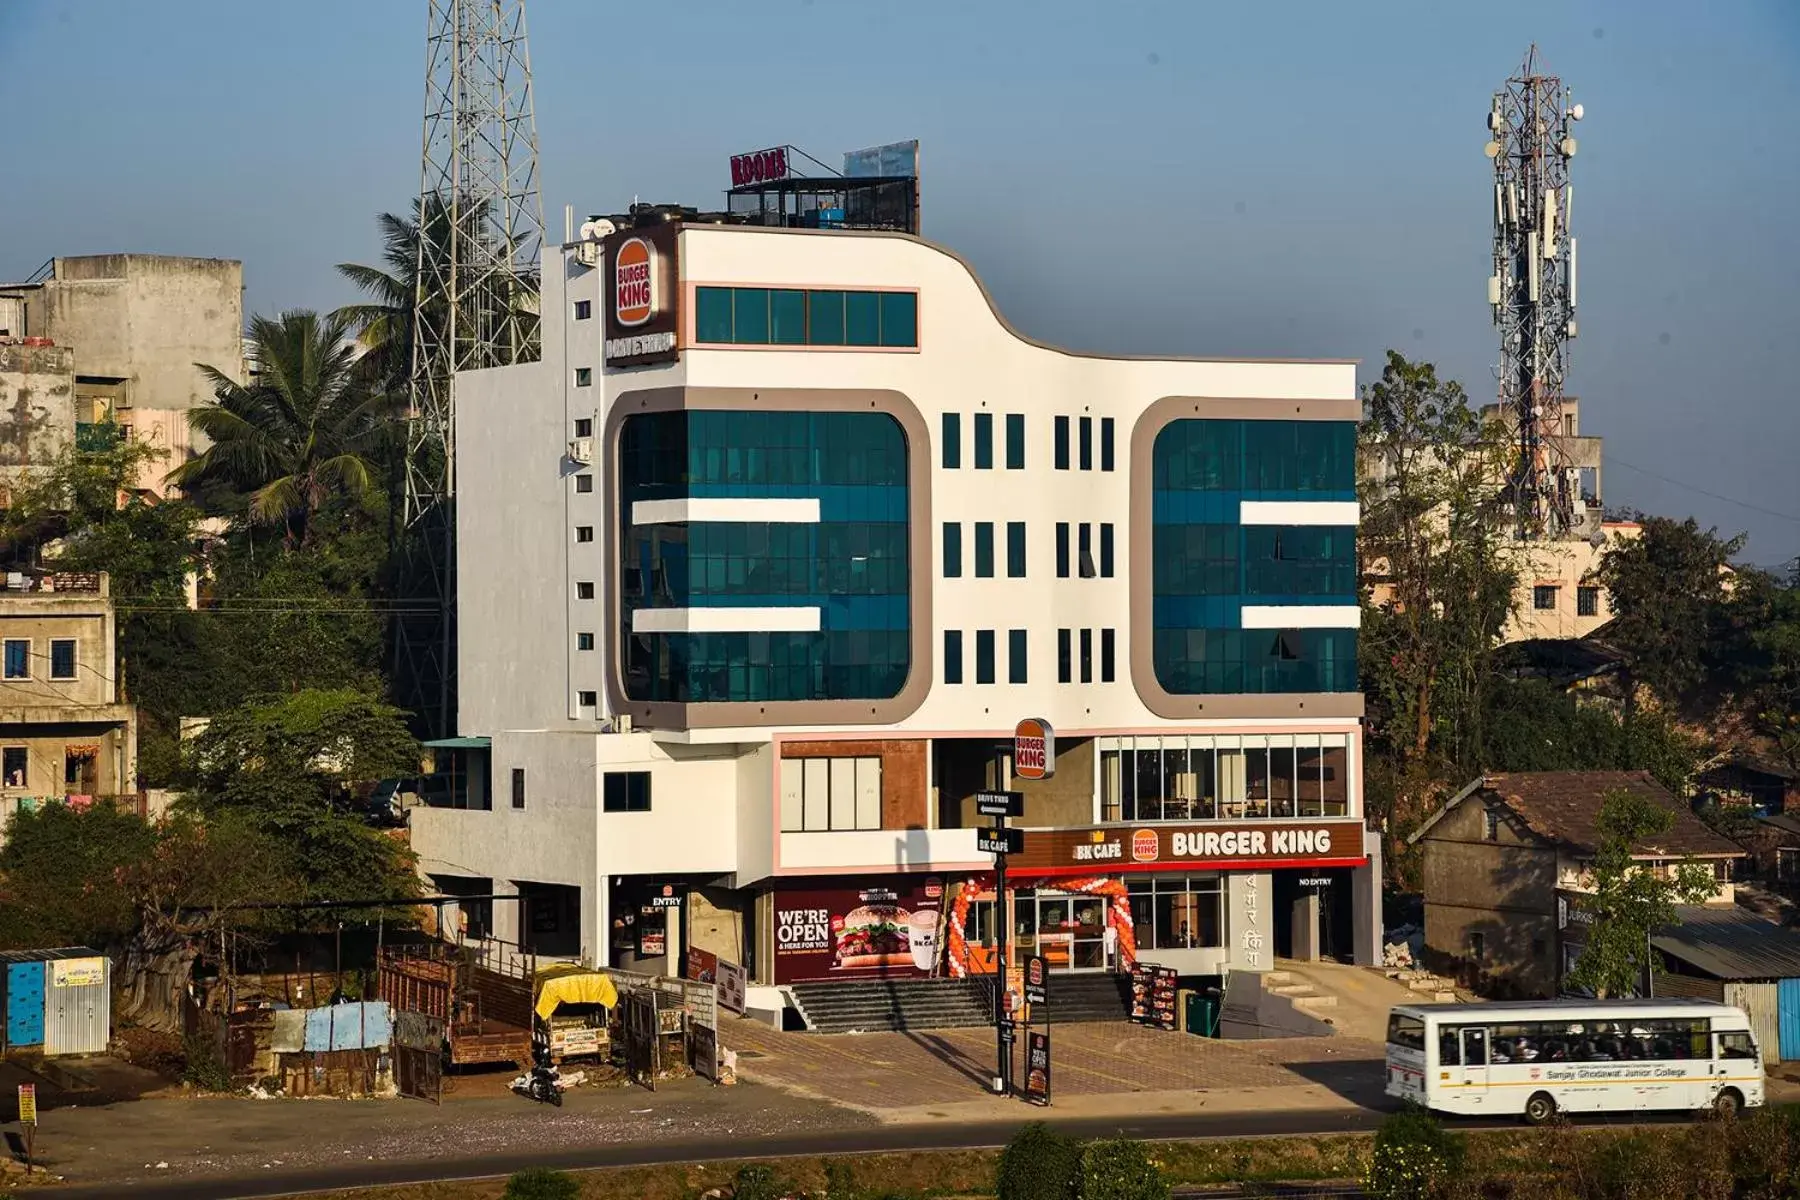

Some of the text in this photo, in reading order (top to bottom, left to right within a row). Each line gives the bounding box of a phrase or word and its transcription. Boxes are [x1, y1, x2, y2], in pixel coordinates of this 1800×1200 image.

[731, 147, 786, 186] ROOMS
[618, 264, 649, 284] BURGER
[618, 281, 651, 308] KING
[1016, 738, 1045, 750] BURGER
[1016, 750, 1046, 767] KING
[977, 794, 1009, 804] DRIVE THRU
[979, 839, 1009, 852] BK CAFÉ
[1075, 838, 1122, 860] BK CAFÉ
[1134, 846, 1158, 854] KING
[1172, 829, 1332, 856] BURGER KING
[1299, 878, 1332, 886] NO ENTRY
[653, 897, 682, 906] ENTRY
[778, 909, 829, 925] WE'RE
[777, 924, 829, 942] OPEN
[1547, 1070, 1575, 1080] Sanjay
[1624, 1068, 1652, 1077] Junior
[1654, 1067, 1687, 1078] College
